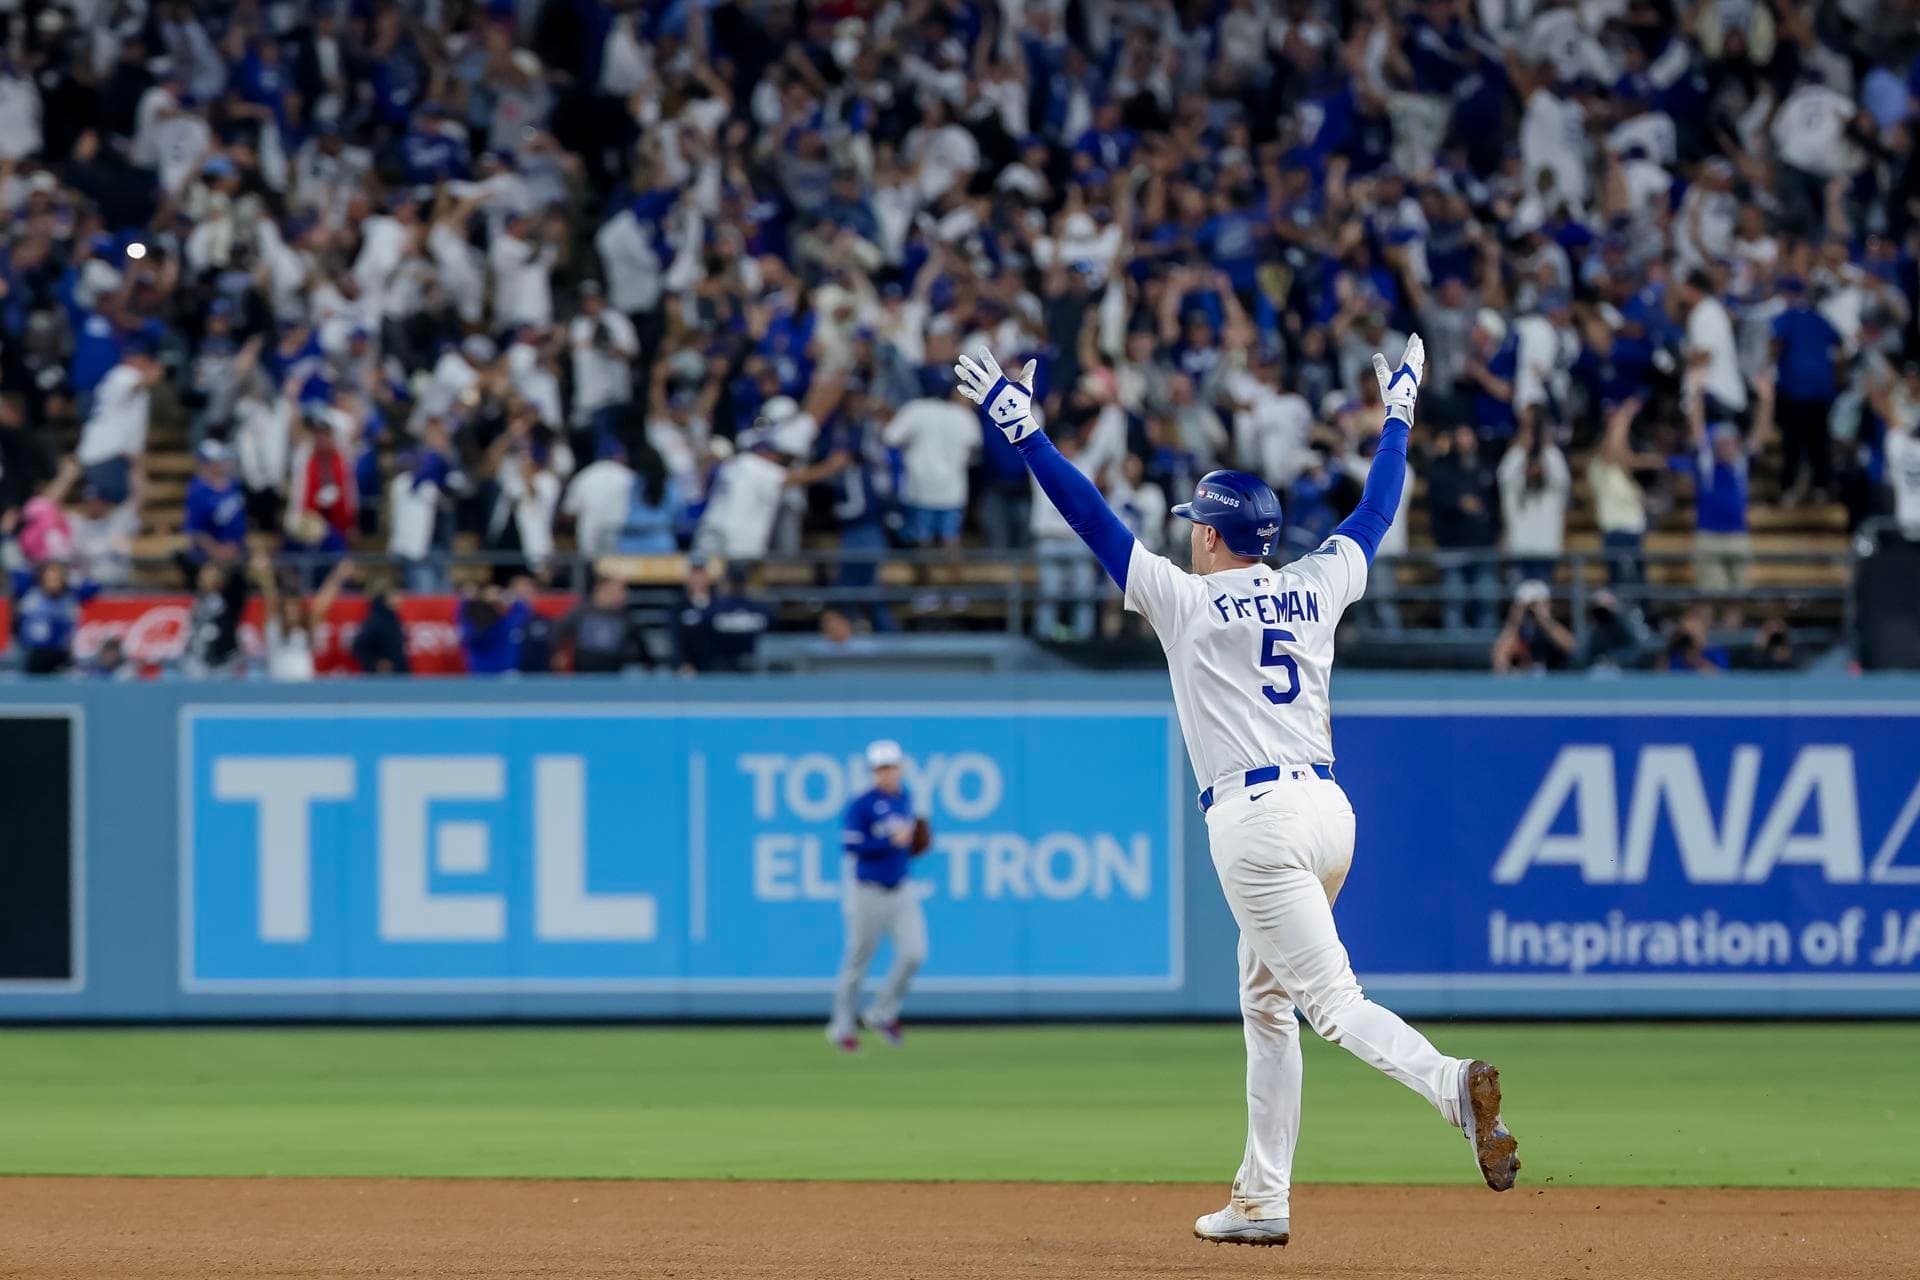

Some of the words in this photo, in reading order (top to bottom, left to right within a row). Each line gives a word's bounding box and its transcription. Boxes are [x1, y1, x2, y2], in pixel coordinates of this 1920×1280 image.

[1206, 491, 1241, 508] STRAUSS
[1262, 543, 1271, 556] 5
[1260, 628, 1301, 705] 5
[1491, 744, 1866, 885] ANA
[211, 755, 658, 943] TEL
[753, 832, 1153, 900] ELTRON
[1488, 909, 1791, 974] Inspiration
[1801, 906, 1866, 966] of
